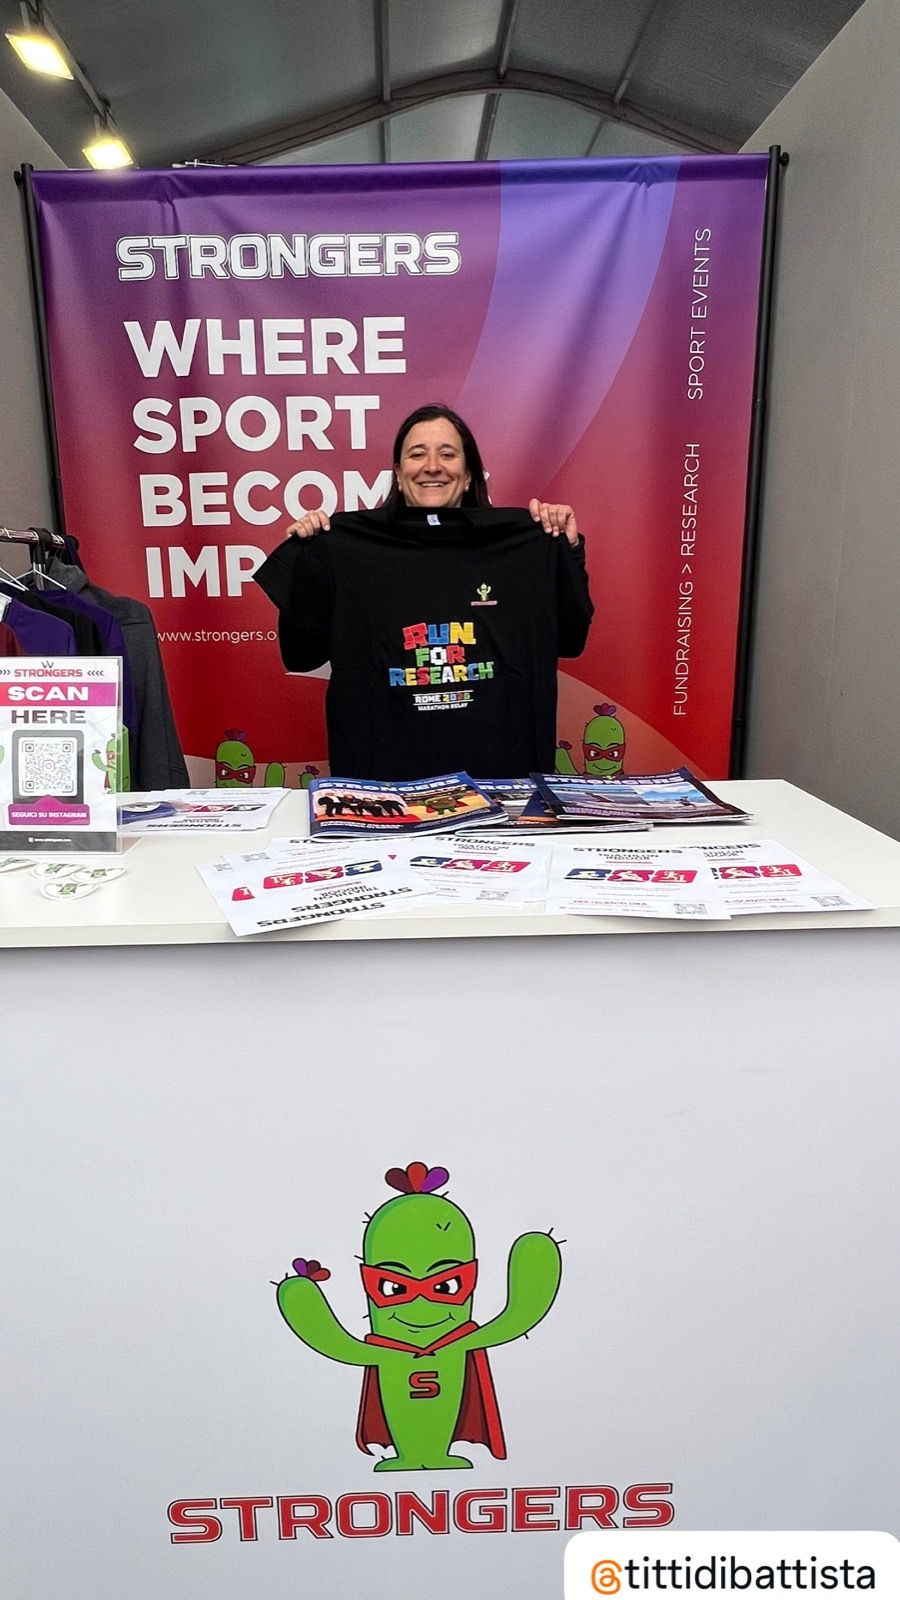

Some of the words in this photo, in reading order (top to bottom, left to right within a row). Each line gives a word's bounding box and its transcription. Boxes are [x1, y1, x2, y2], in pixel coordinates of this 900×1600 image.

[116, 232, 462, 281] STRONGERS
[691, 228, 711, 318] EVENTS
[124, 317, 407, 377] WHERE
[688, 326, 706, 400] SPORT
[132, 395, 380, 454] SPORT
[140, 470, 492, 527] BECOM
[681, 443, 700, 556] RESEARCH
[146, 545, 267, 598] IMP
[157, 629, 277, 643] www.strongers.o
[402, 622, 477, 650] RUN
[673, 581, 694, 716] FUNDRAISING
[415, 645, 466, 667] FOR
[14, 668, 83, 678] STRONGERS
[389, 661, 495, 687] RESEARCH
[7, 685, 89, 701] SCAN
[415, 695, 441, 703] ROME
[11, 709, 87, 724] HERE
[318, 778, 461, 791] STRONGERS
[543, 776, 684, 785] STRONGERS
[435, 836, 536, 847] STRONGERS
[291, 886, 413, 913] STRONGERS
[410, 1371, 441, 1398] S
[167, 1483, 675, 1544] STRONGERS
